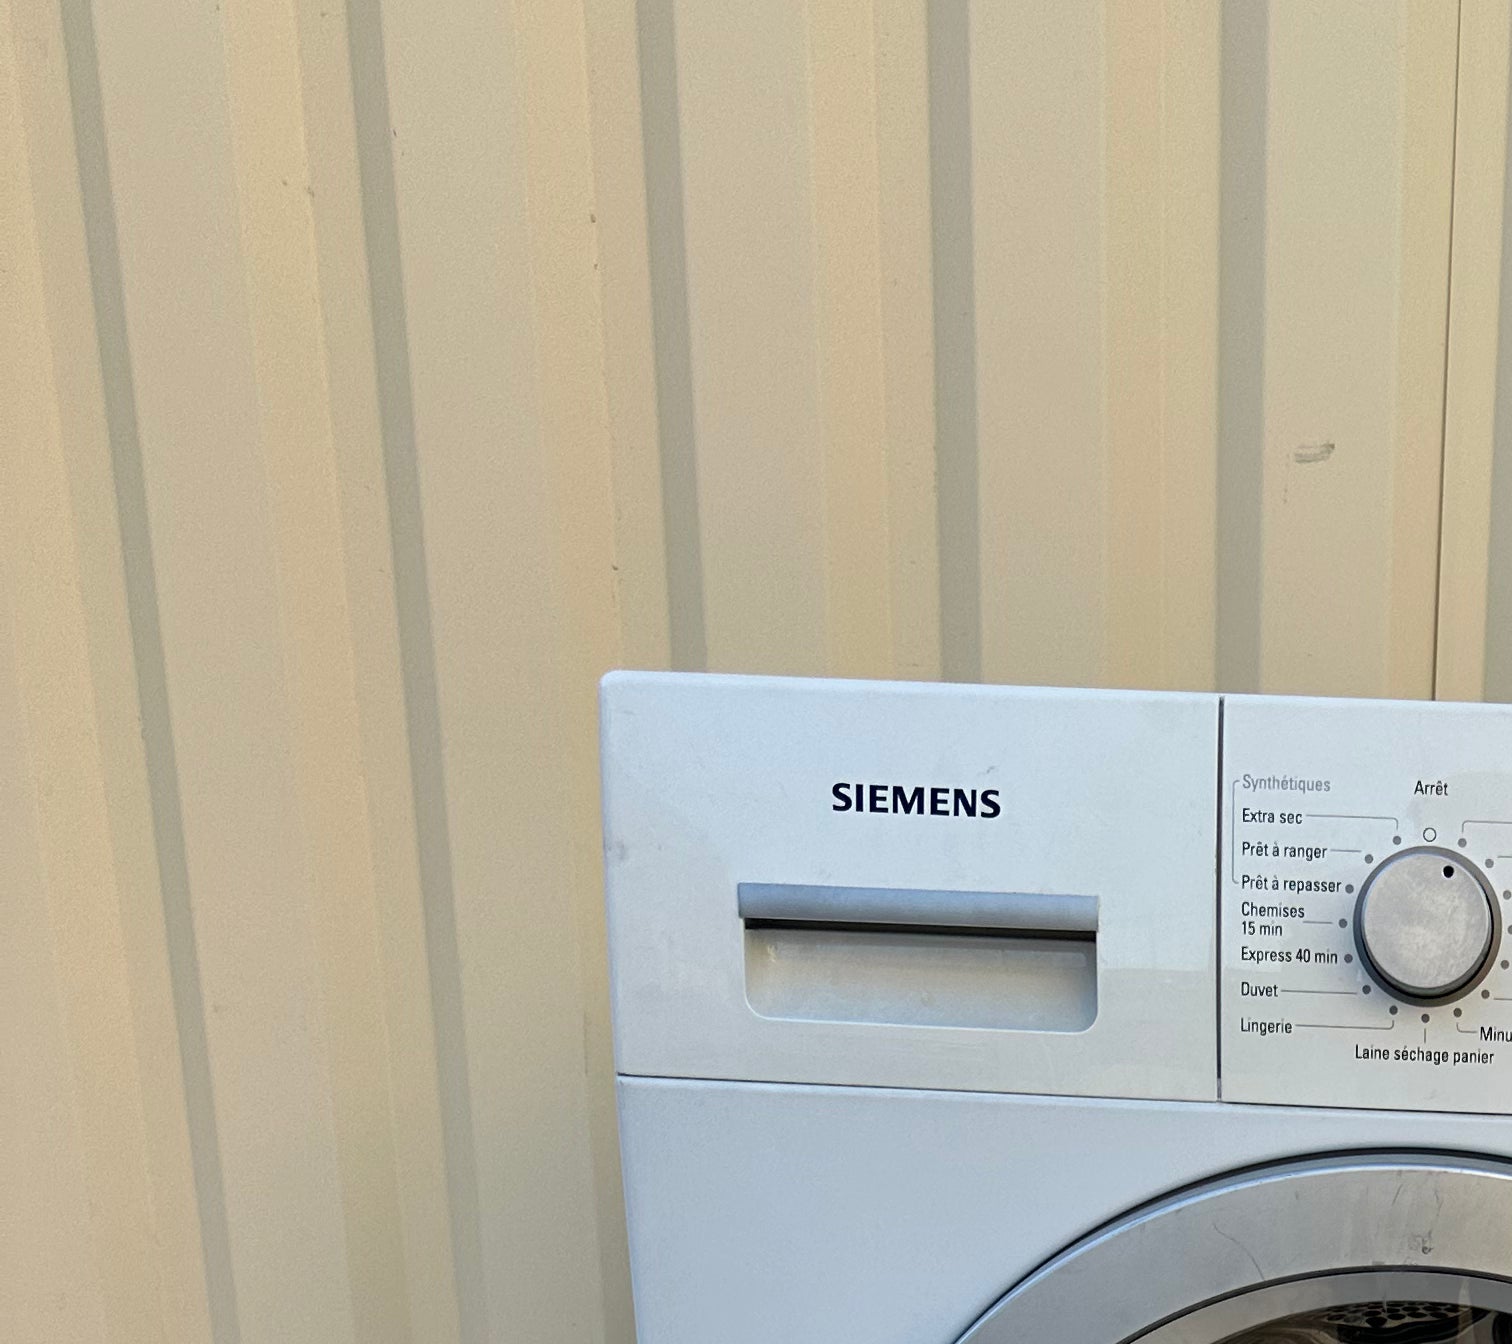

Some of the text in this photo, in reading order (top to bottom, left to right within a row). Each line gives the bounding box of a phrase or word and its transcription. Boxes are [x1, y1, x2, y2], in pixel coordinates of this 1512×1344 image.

[1242, 774, 1330, 792] Synthétiques
[1414, 779, 1448, 795] Arrêt
[832, 782, 1001, 818] SIEMENS
[1242, 807, 1302, 823] Extra sec
[1241, 841, 1327, 860] Prêt à ranger
[1241, 874, 1341, 893] Prêt à repasser
[1241, 901, 1304, 917] Chemises
[1241, 920, 1282, 935] 15 min
[1241, 946, 1337, 964] Express 40 min
[1241, 981, 1278, 996] Duvet
[1241, 1017, 1292, 1035] Lingerie
[1355, 1044, 1494, 1064] Laine séchage panier
